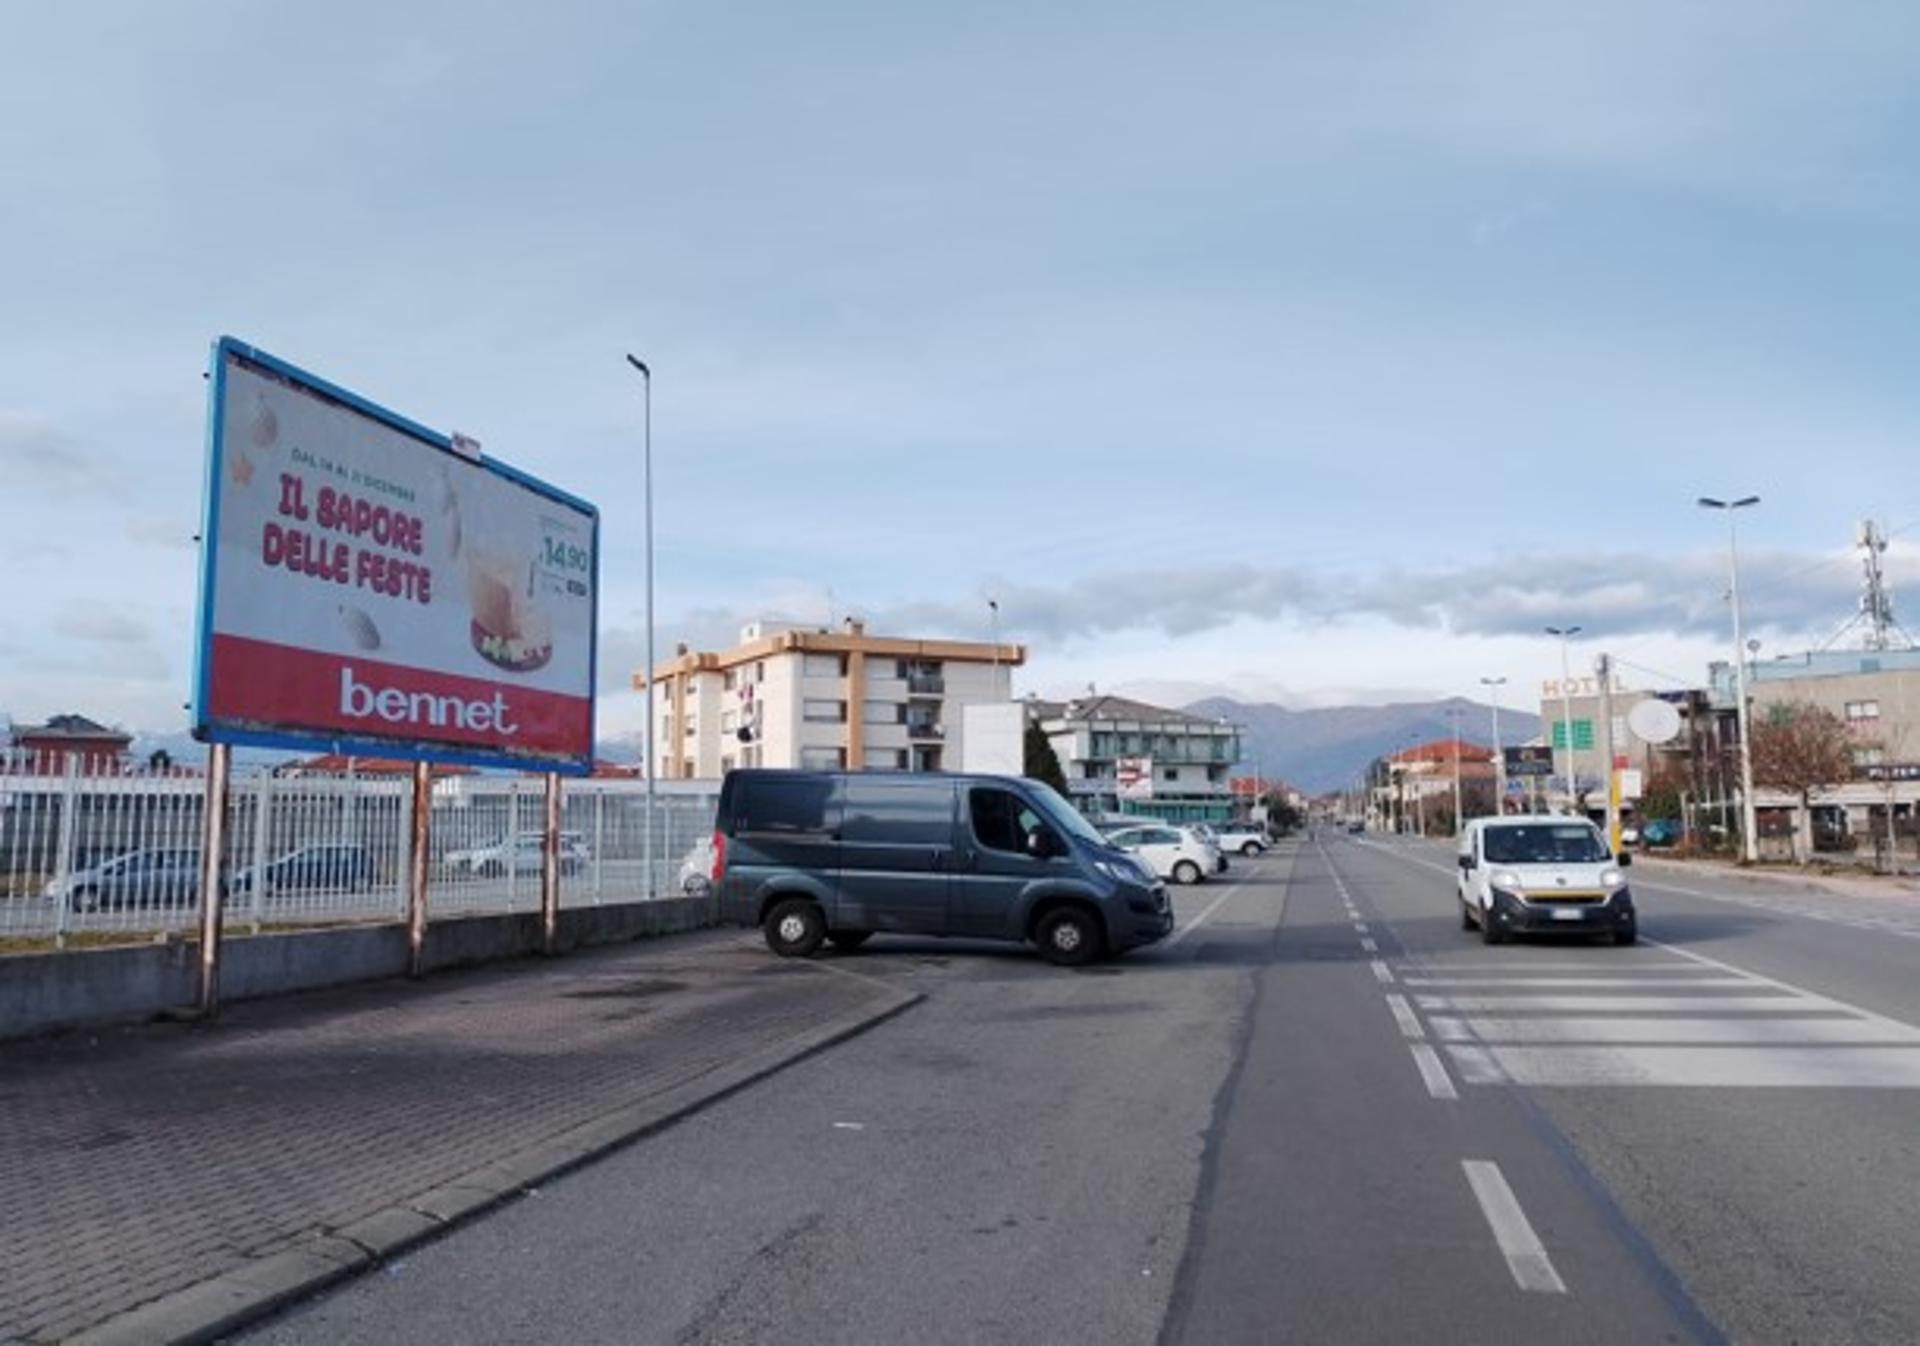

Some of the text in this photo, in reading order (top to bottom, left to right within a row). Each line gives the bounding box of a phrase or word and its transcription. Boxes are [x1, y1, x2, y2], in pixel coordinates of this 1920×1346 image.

[279, 472, 423, 557] IL SAPORE
[262, 520, 432, 606] DELLE FESTE
[341, 667, 519, 736] bennet
[1542, 674, 1629, 698] HOTL
